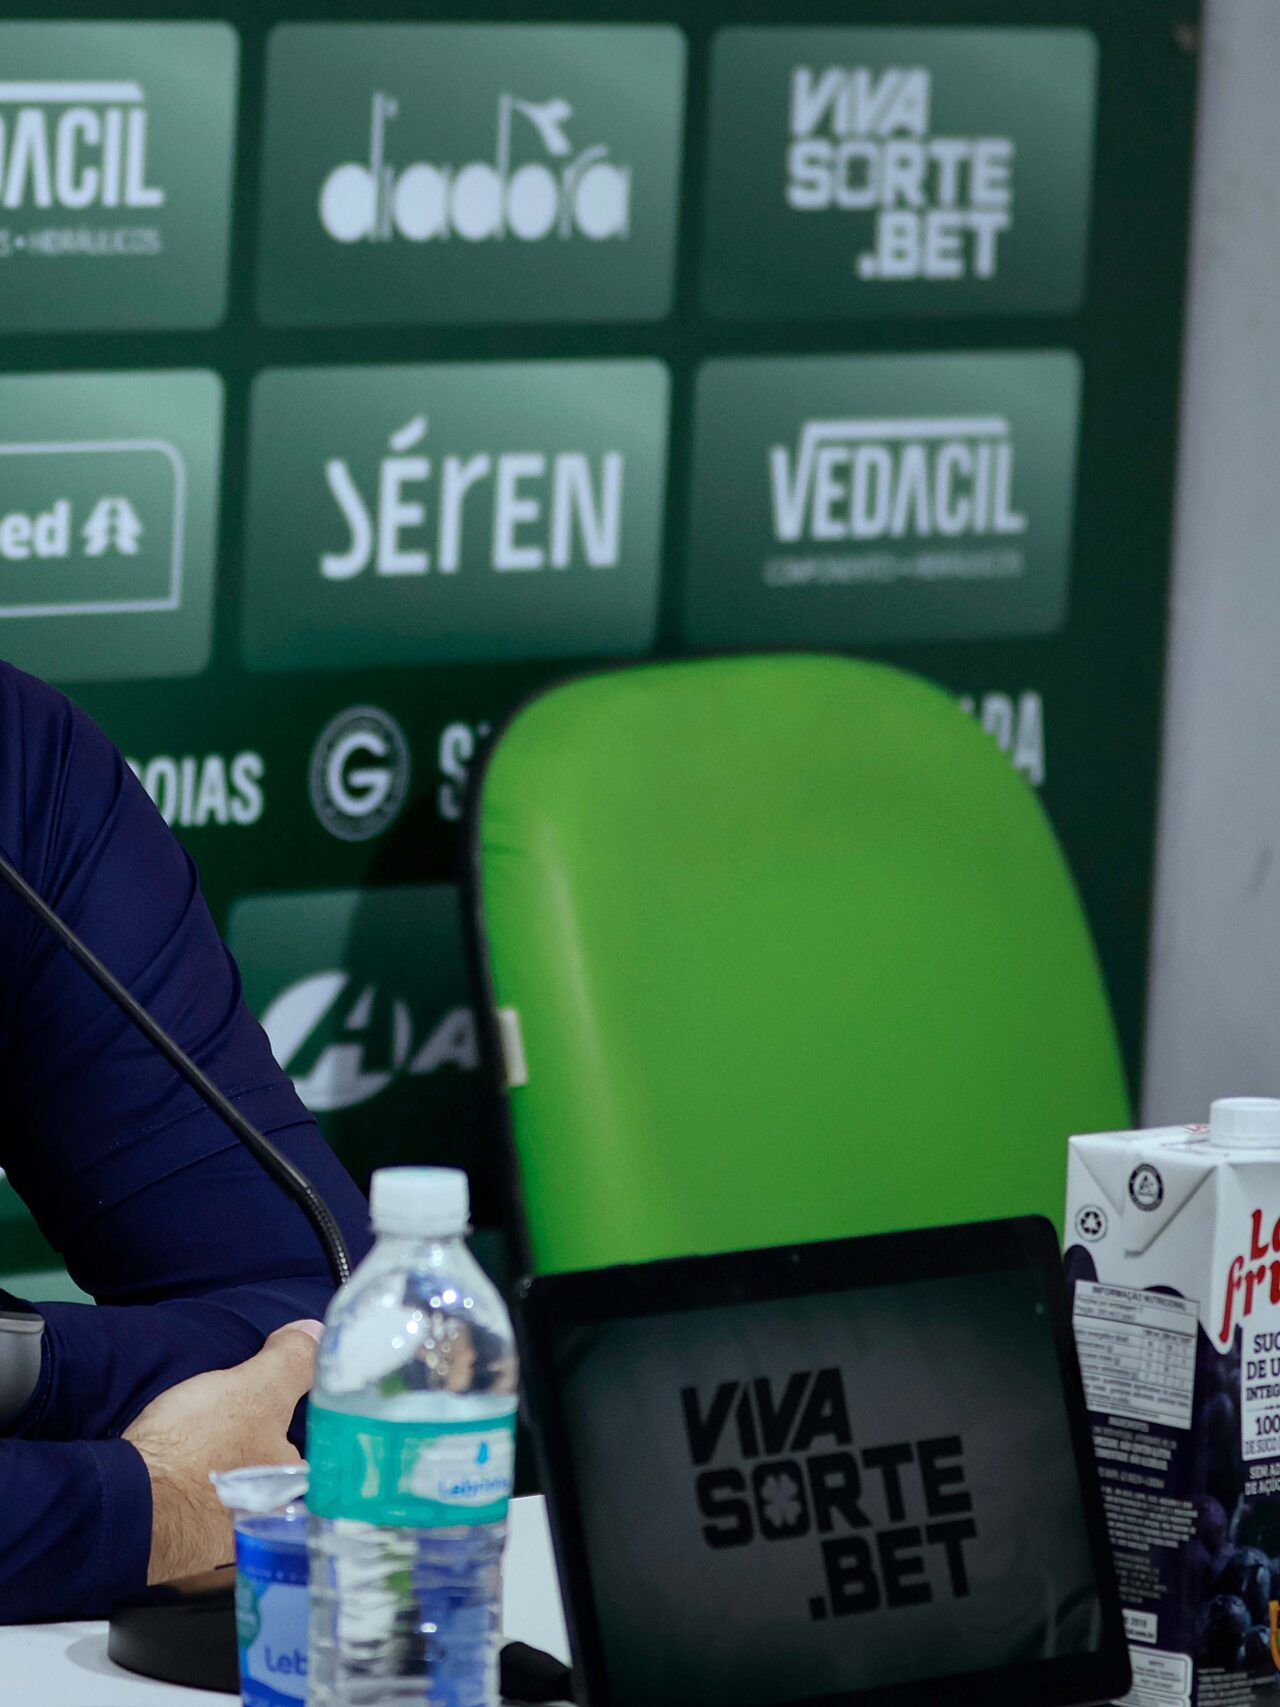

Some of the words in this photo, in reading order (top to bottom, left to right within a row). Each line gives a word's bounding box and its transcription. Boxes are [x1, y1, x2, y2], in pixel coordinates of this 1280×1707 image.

[790, 65, 932, 136] VIVA
[320, 92, 631, 243] diadora
[786, 137, 1014, 210] SORTE
[771, 416, 1025, 542] VEDACIL
[124, 750, 265, 828] OIAS
[679, 1367, 852, 1466] VIVA
[1247, 1359, 1267, 1381] DE
[694, 1434, 973, 1550] SORTE
[809, 1517, 978, 1621] .BET
